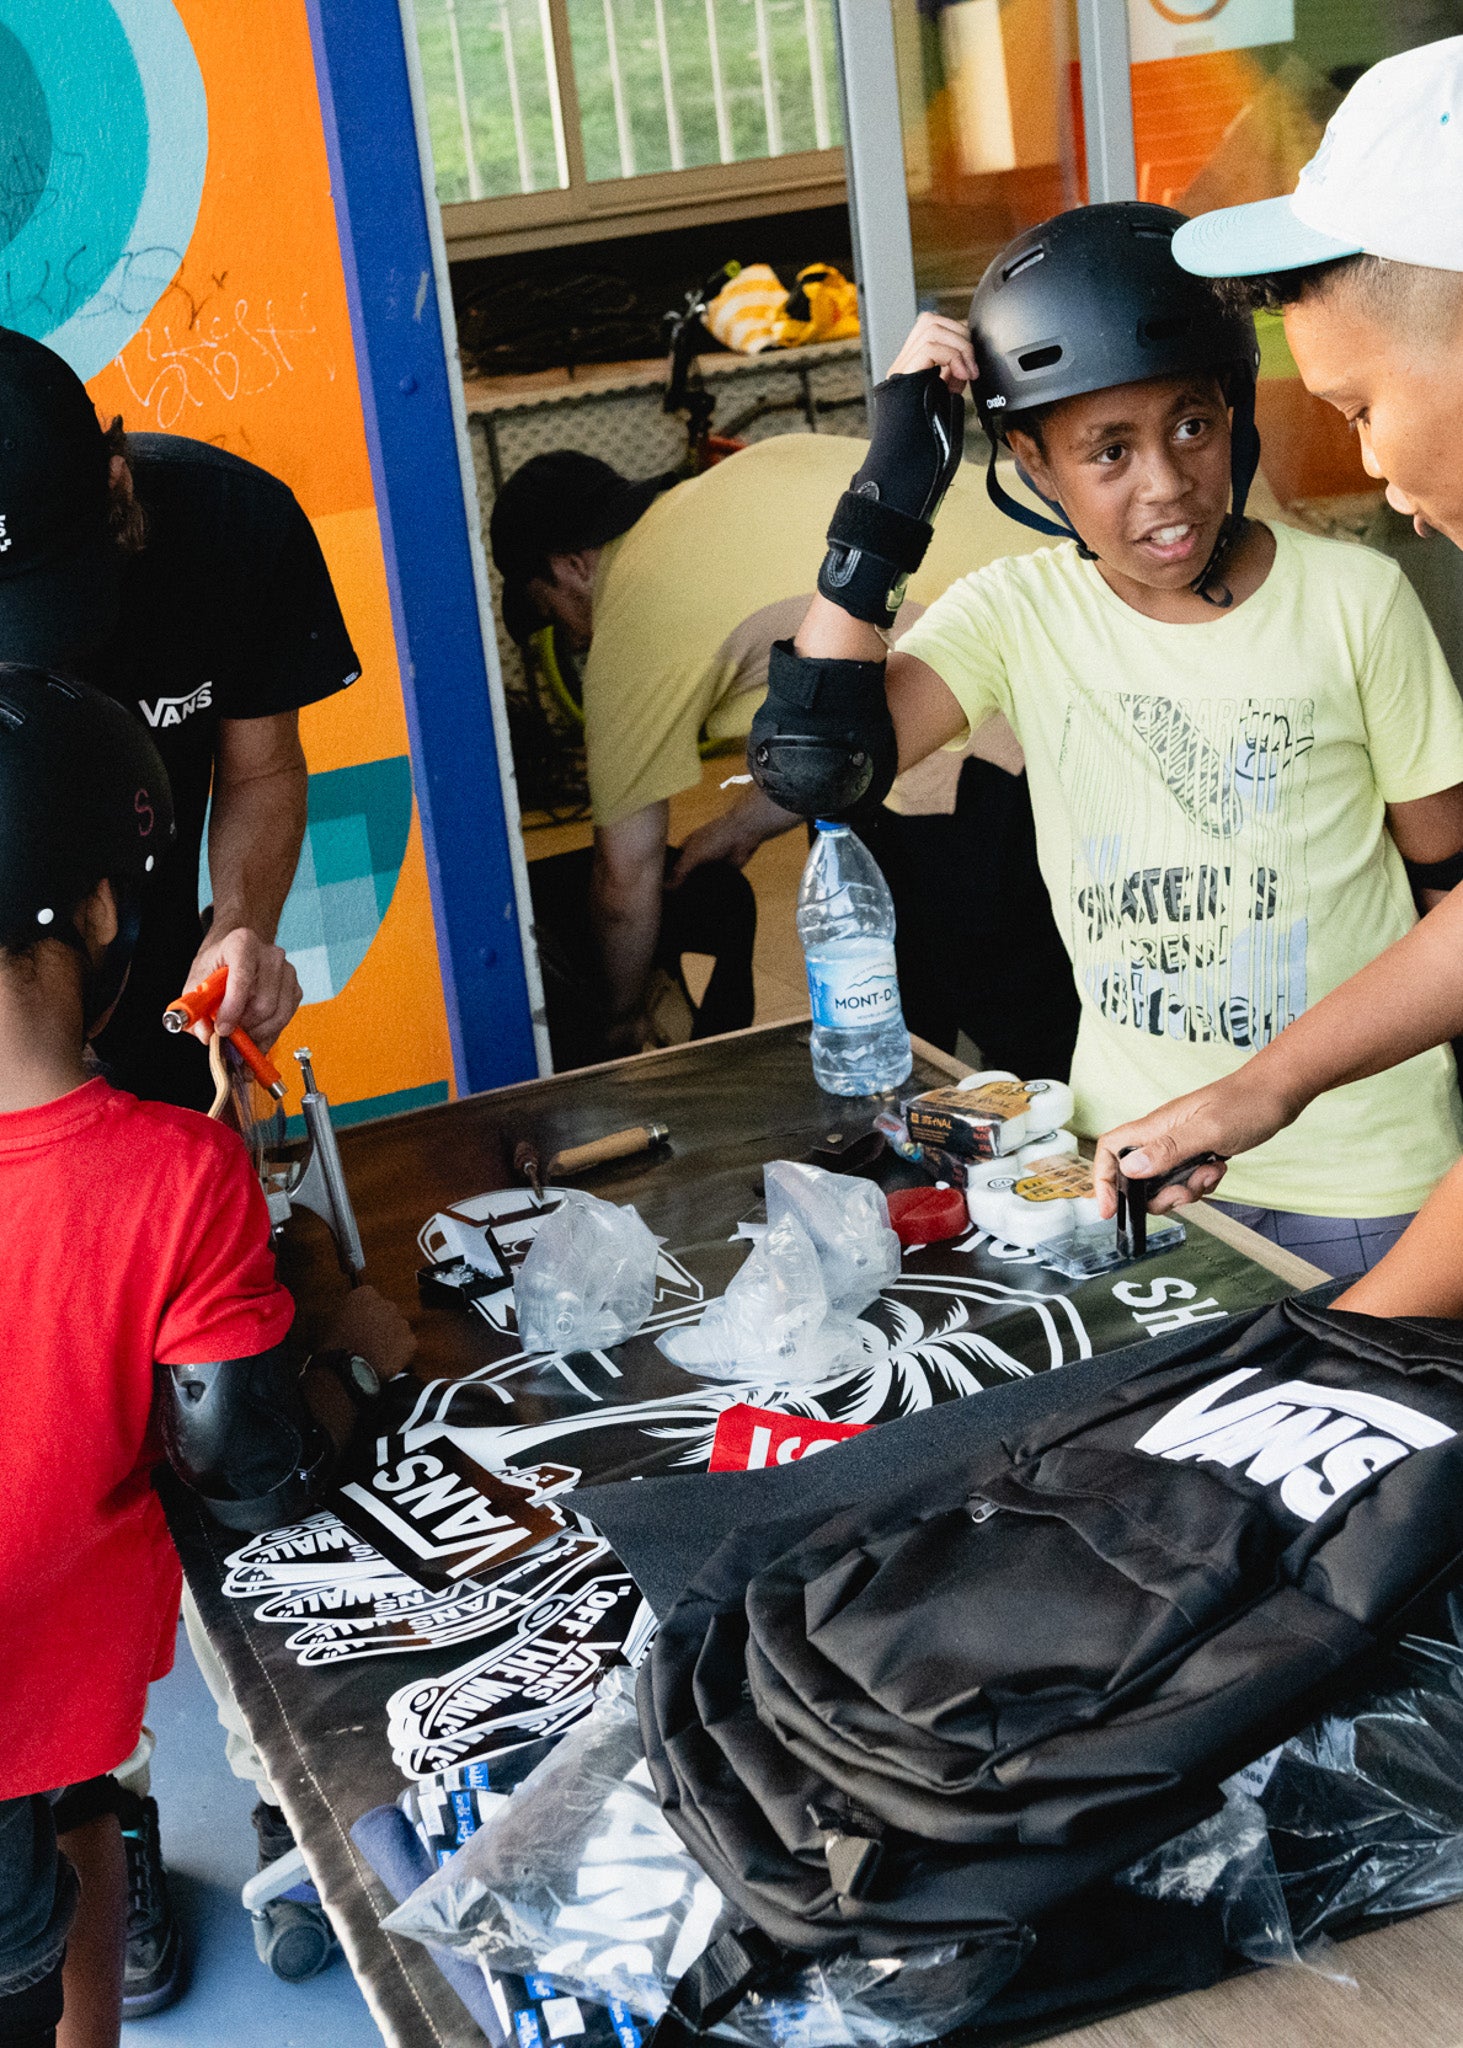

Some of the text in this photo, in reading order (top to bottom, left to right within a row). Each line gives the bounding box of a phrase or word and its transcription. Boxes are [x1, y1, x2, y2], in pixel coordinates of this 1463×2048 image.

[138, 681, 213, 727] VANS
[1134, 1367, 1458, 1524] VANS
[340, 1454, 532, 1579] VANS
[486, 1637, 579, 1686] THE
[521, 1641, 622, 1704] VANS
